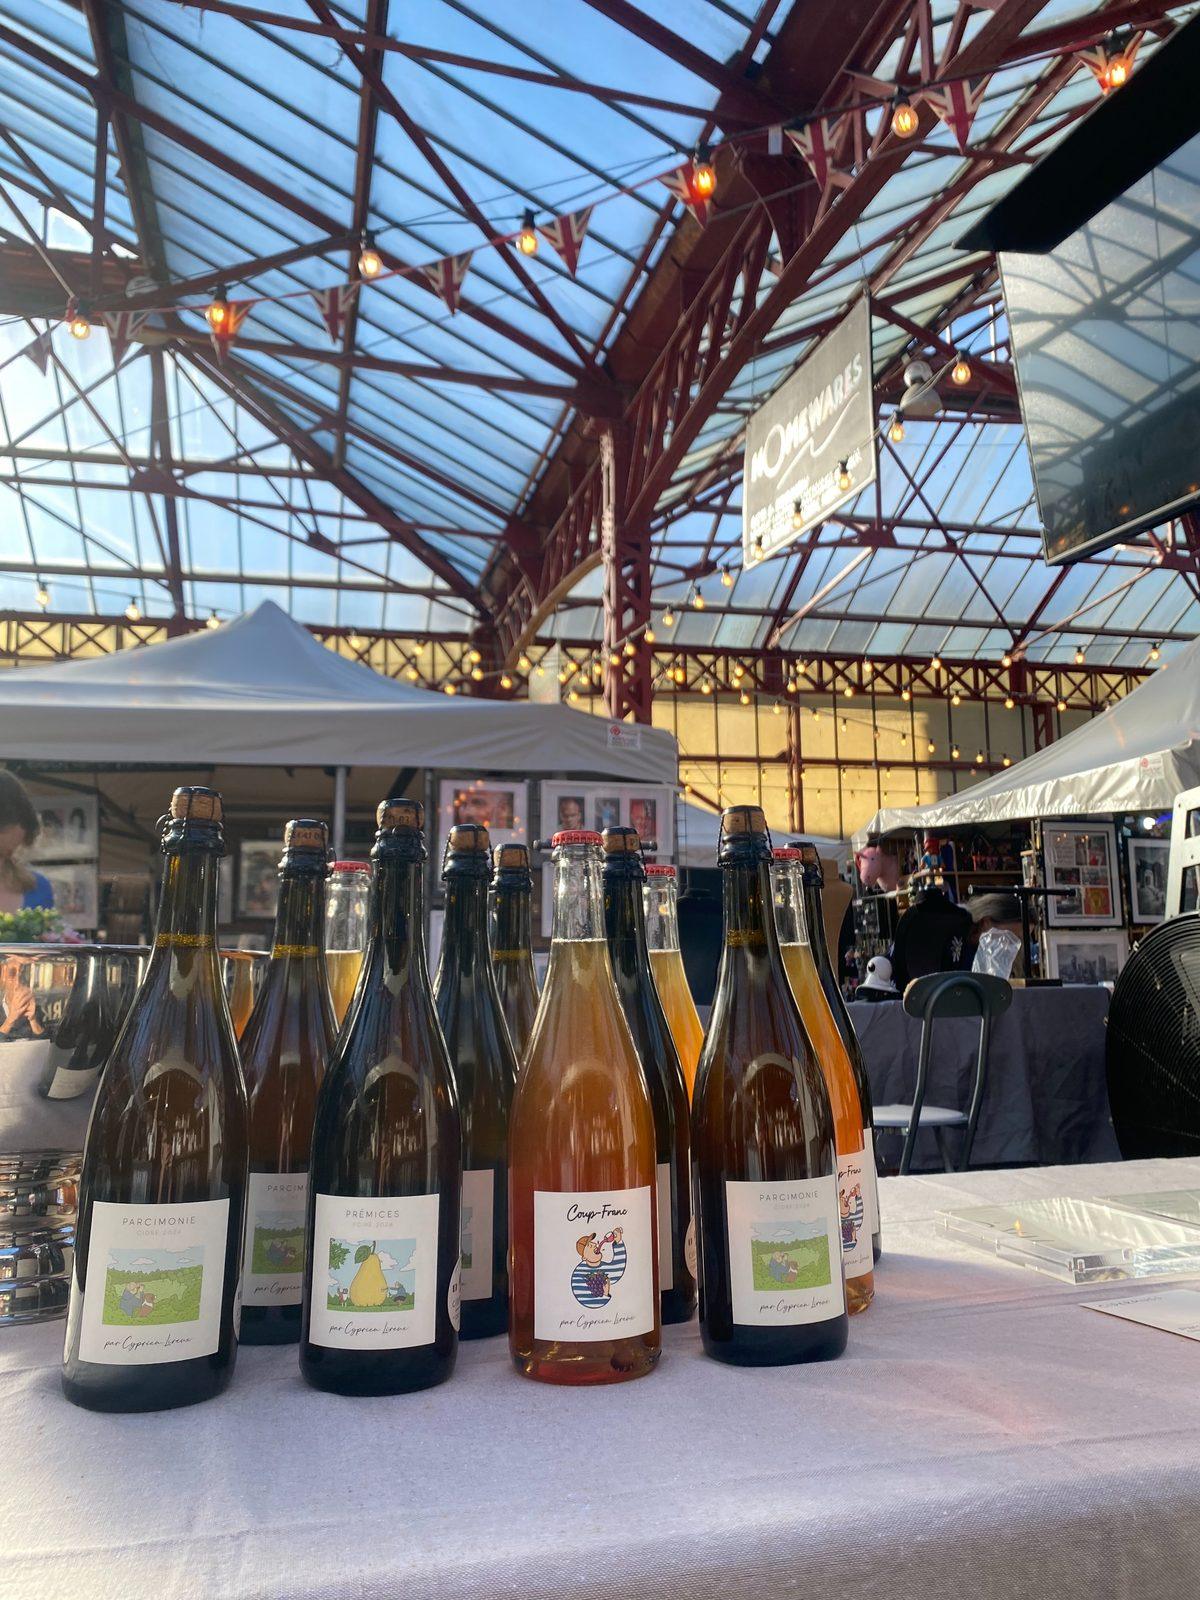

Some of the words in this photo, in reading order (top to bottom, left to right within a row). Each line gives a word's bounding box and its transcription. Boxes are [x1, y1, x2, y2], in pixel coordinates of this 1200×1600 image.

[267, 1184, 304, 1192] PARCIM
[759, 1190, 818, 1201] PARCIMONIE
[345, 1208, 400, 1219] PRÉMICES
[566, 1203, 628, 1223] Coup-Franc
[122, 1216, 196, 1227] PARCIMONIE
[759, 1304, 776, 1313] par
[559, 1319, 576, 1328] par
[328, 1325, 345, 1335] par
[103, 1340, 121, 1350] par
